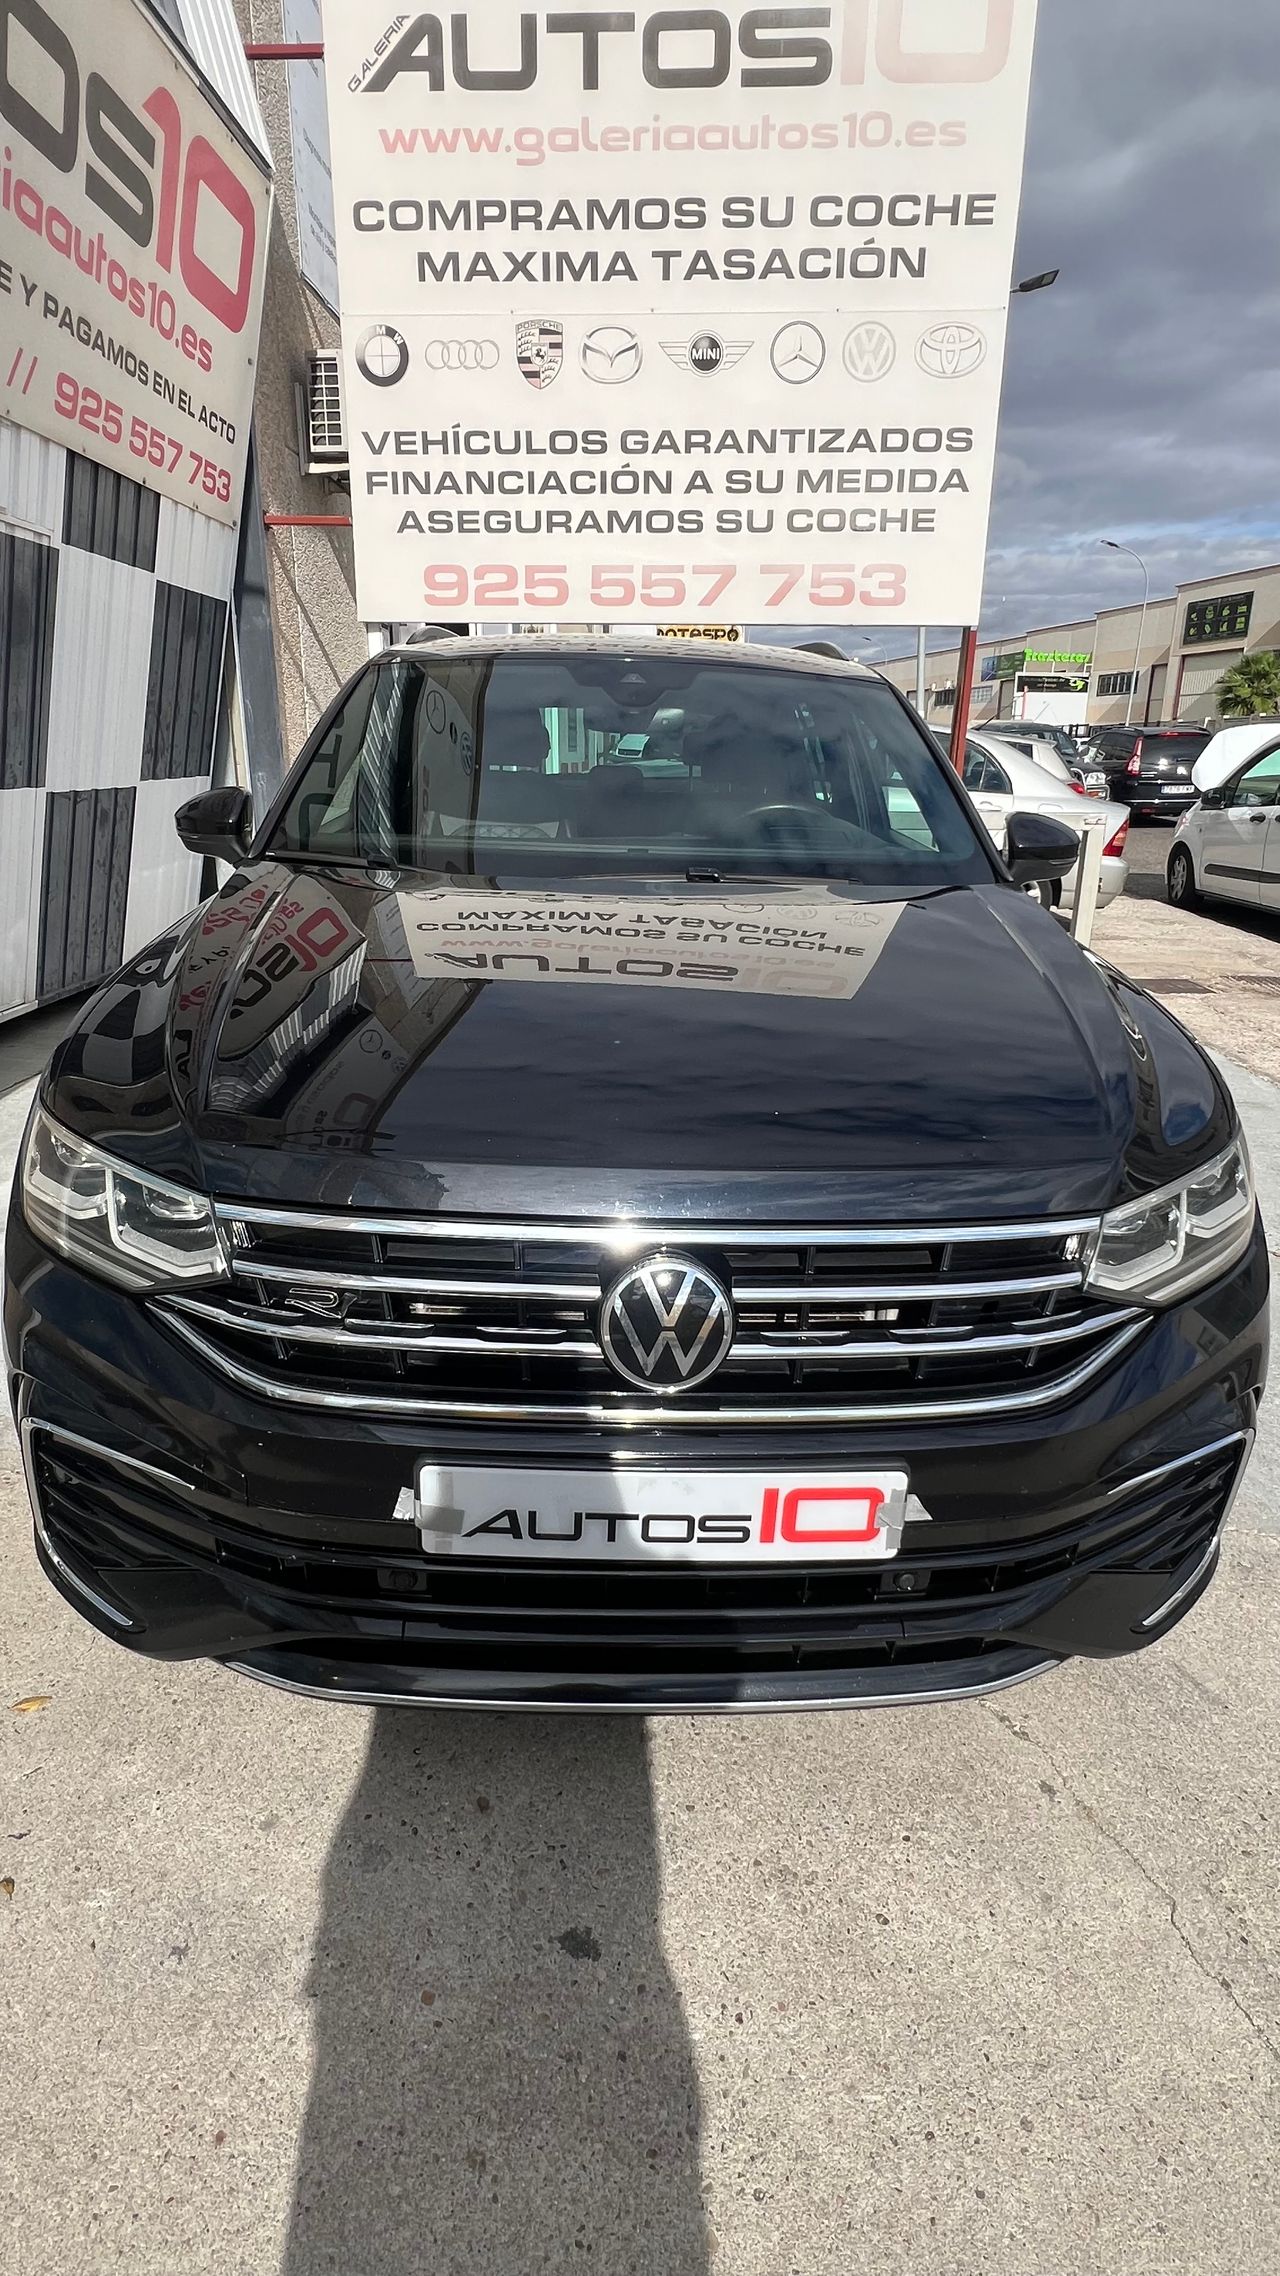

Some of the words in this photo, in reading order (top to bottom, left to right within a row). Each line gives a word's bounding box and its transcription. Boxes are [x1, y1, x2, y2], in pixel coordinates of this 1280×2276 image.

[347, 14, 412, 93] GALERIA
[378, 111, 966, 166] www.galeriaautos10.es
[353, 197, 707, 232] COMPRAMOS
[722, 196, 795, 229] SU
[810, 193, 997, 228] COCHE
[0, 145, 213, 372] iaautos10.es
[417, 250, 638, 282] MAXIMA
[651, 237, 926, 281] TASACIÓN
[516, 319, 562, 332] PORSCHE
[19, 273, 38, 307] Y
[43, 291, 149, 387] PAGAMOS
[152, 367, 176, 405] EN
[177, 388, 196, 419] EL
[198, 405, 236, 445] ACTO
[690, 347, 720, 362] MINI
[54, 372, 123, 445] 925
[129, 415, 183, 474] 557
[188, 450, 232, 503] 753
[361, 422, 608, 455] VEHÍCULOS
[620, 427, 974, 455] GARANTIZADOS
[366, 462, 673, 495] FINANCIACIÓN
[683, 470, 714, 494] A
[725, 469, 784, 494] SU
[796, 468, 970, 493] MEDIDA
[396, 510, 704, 534] ASEGURAMOS
[716, 509, 774, 533] SU
[786, 508, 937, 533] COCHE
[423, 564, 570, 607] 925
[590, 564, 737, 607] 557
[759, 563, 907, 607] 753
[461, 1487, 885, 1544] AUTOS10
